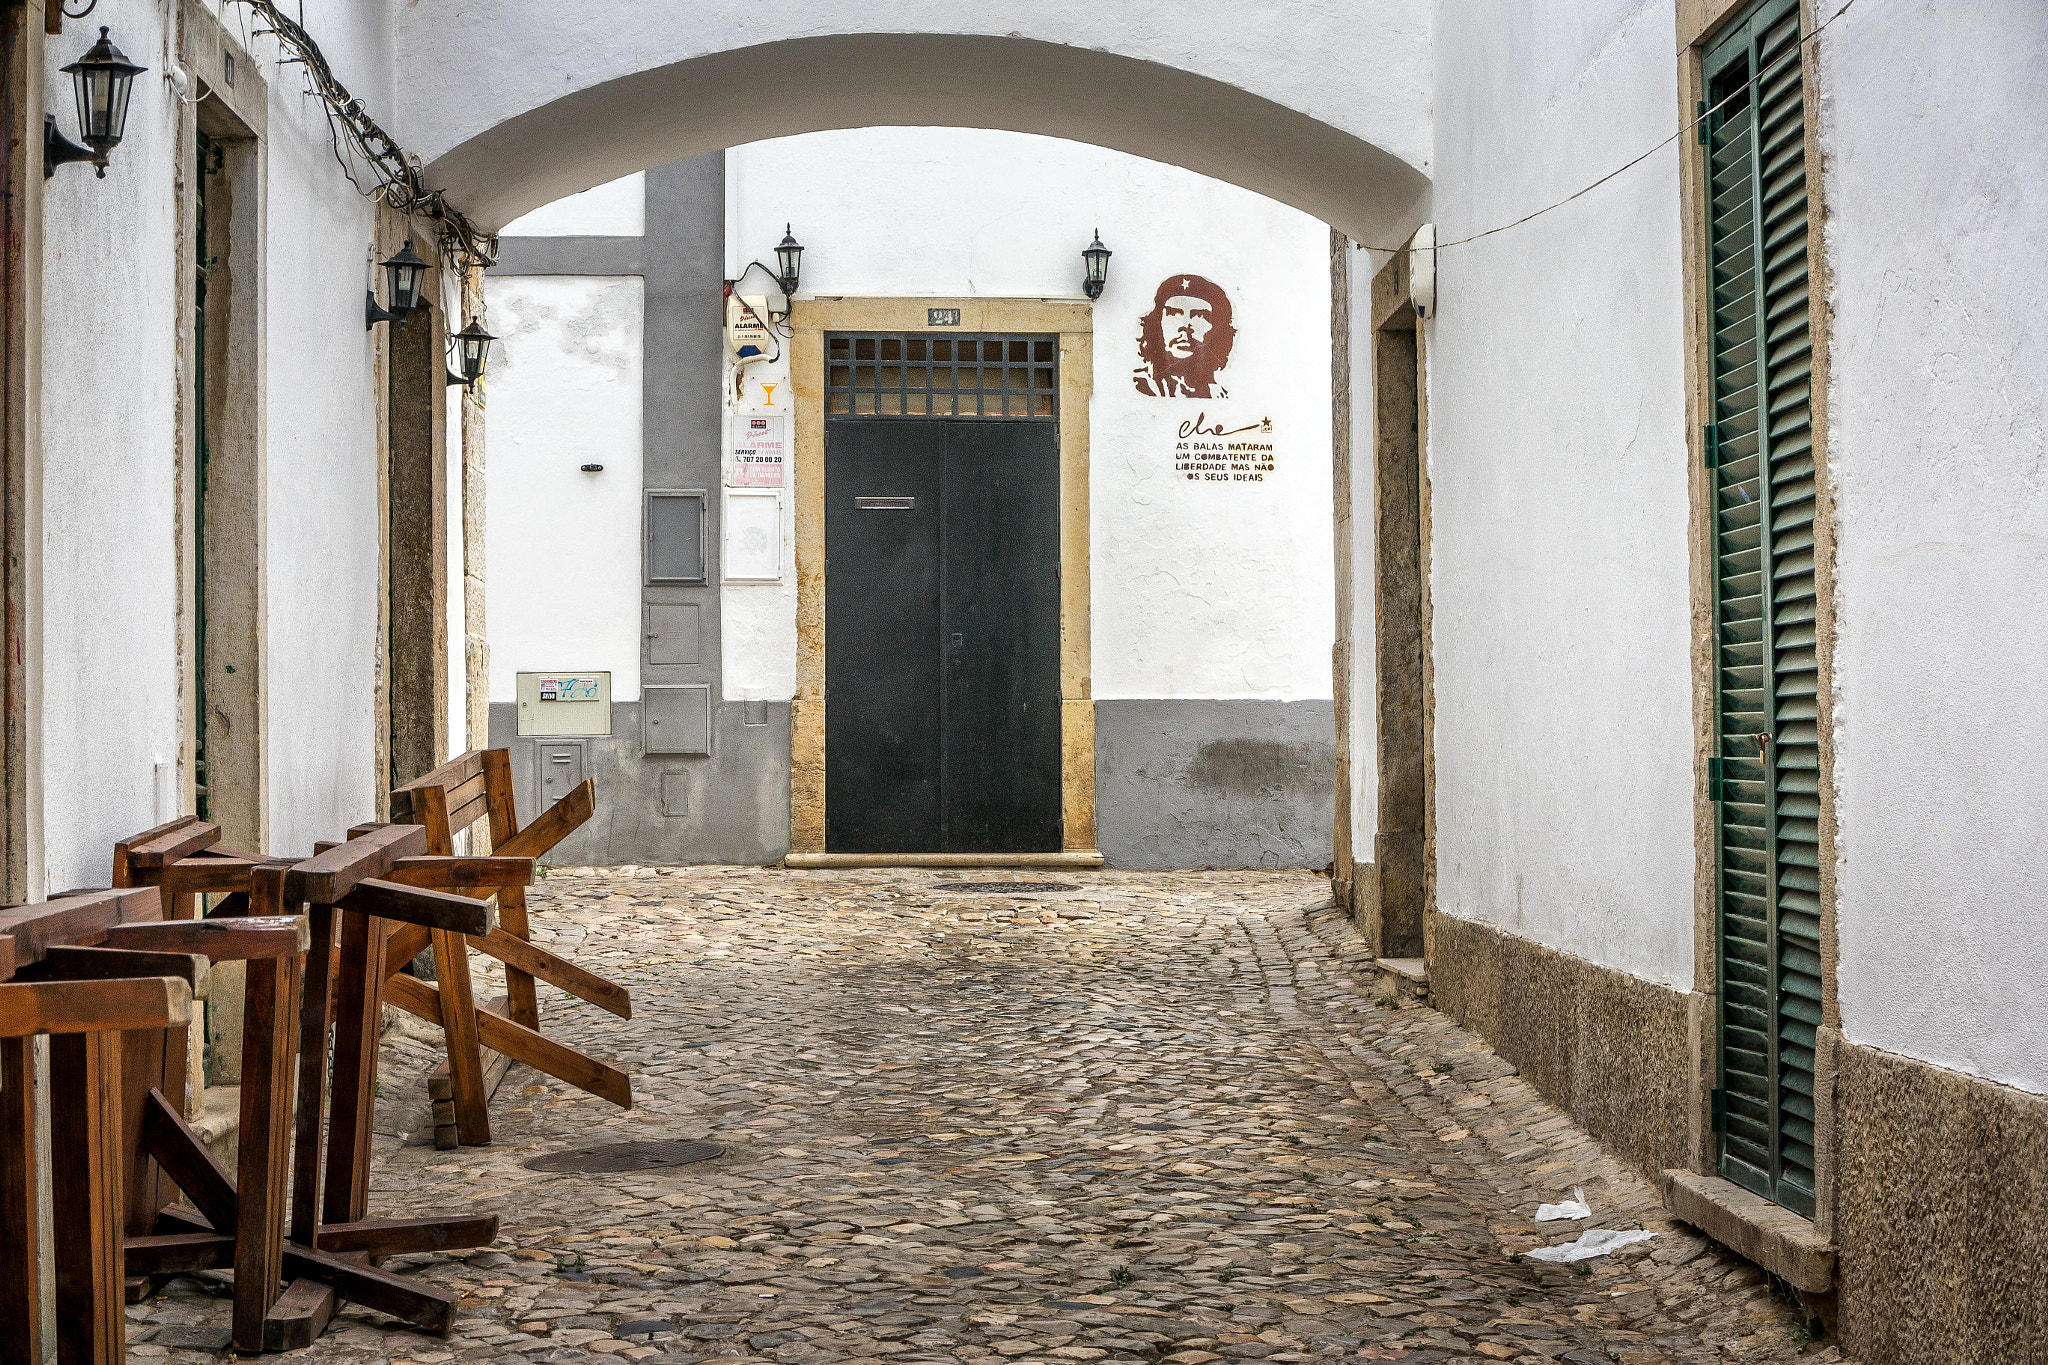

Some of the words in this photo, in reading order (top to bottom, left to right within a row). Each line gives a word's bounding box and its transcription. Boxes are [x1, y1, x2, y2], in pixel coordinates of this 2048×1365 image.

[1176, 442, 1189, 450] AS
[1193, 442, 1224, 451] BALAS
[1227, 443, 1273, 451] MATARAM
[1194, 453, 1257, 461] COMBATENTE
[1261, 454, 1274, 462] DA
[1231, 463, 1250, 471] MAS
[1254, 463, 1275, 471] NÃO
[1204, 473, 1229, 481] SEUS
[1233, 473, 1263, 482] IDEAIS
